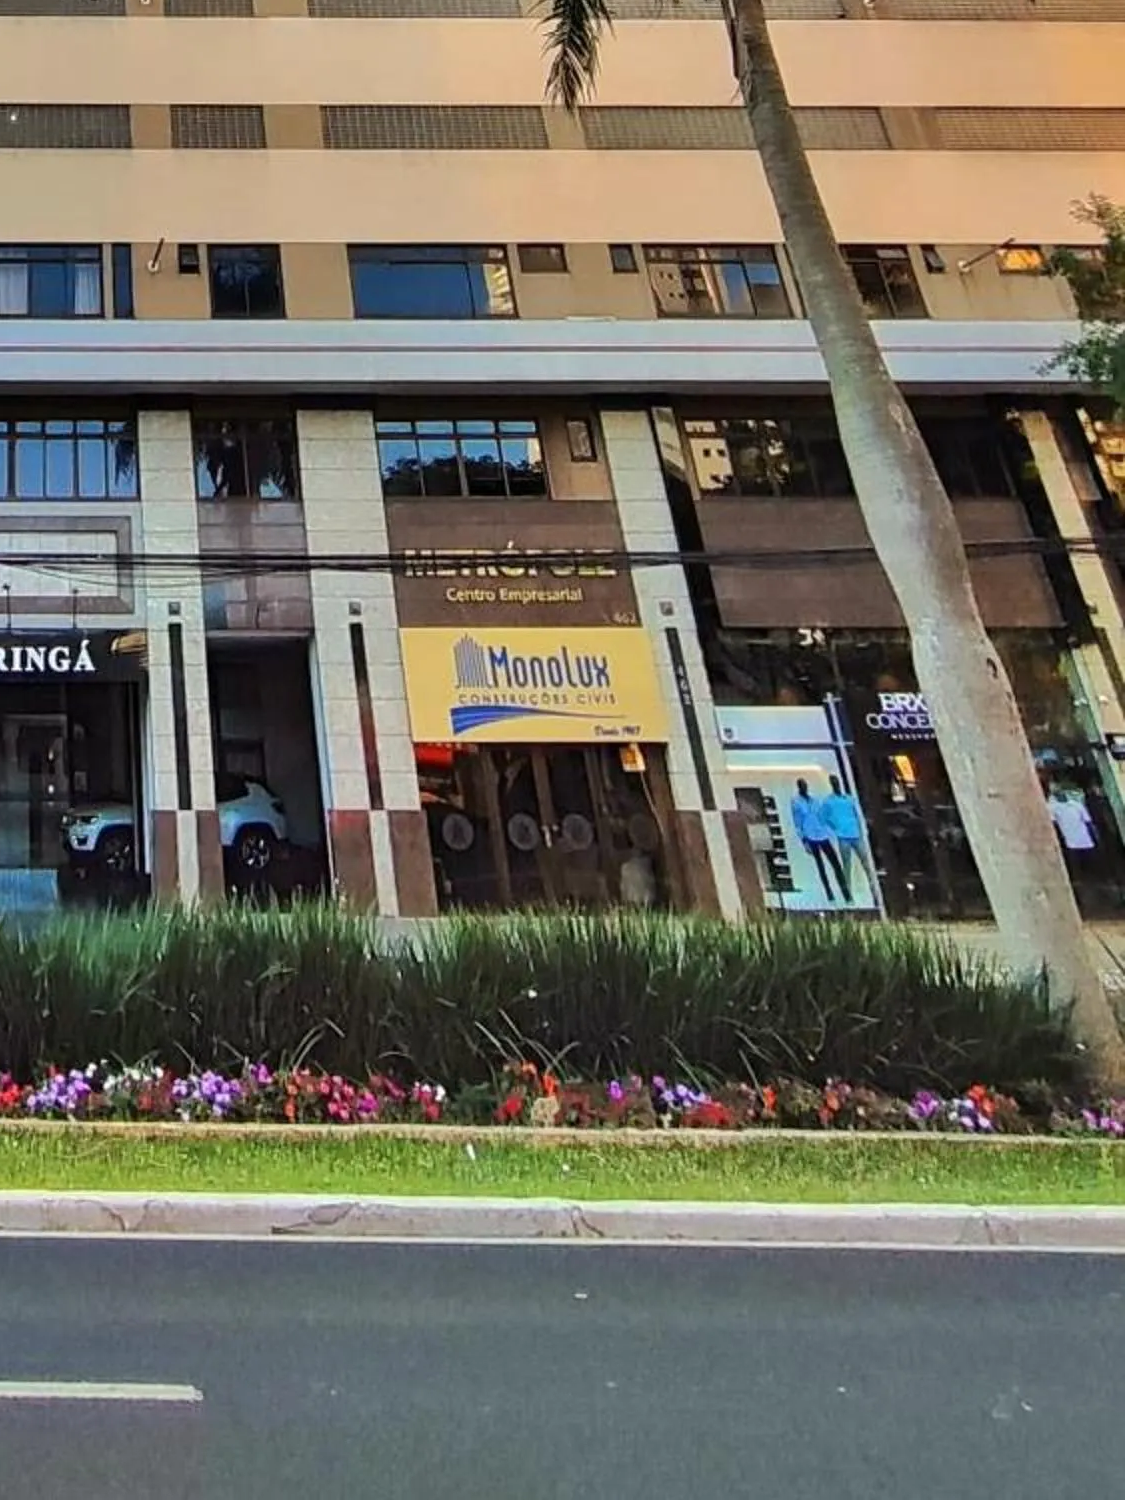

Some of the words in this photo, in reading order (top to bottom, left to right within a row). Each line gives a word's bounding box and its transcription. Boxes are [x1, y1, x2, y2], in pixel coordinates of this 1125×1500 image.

[446, 587, 496, 602] Centro
[499, 587, 583, 605] Empresarial
[458, 690, 569, 706] CONSTRUÇÕES
[576, 693, 616, 705] CIVIS
[878, 692, 928, 711] BRX
